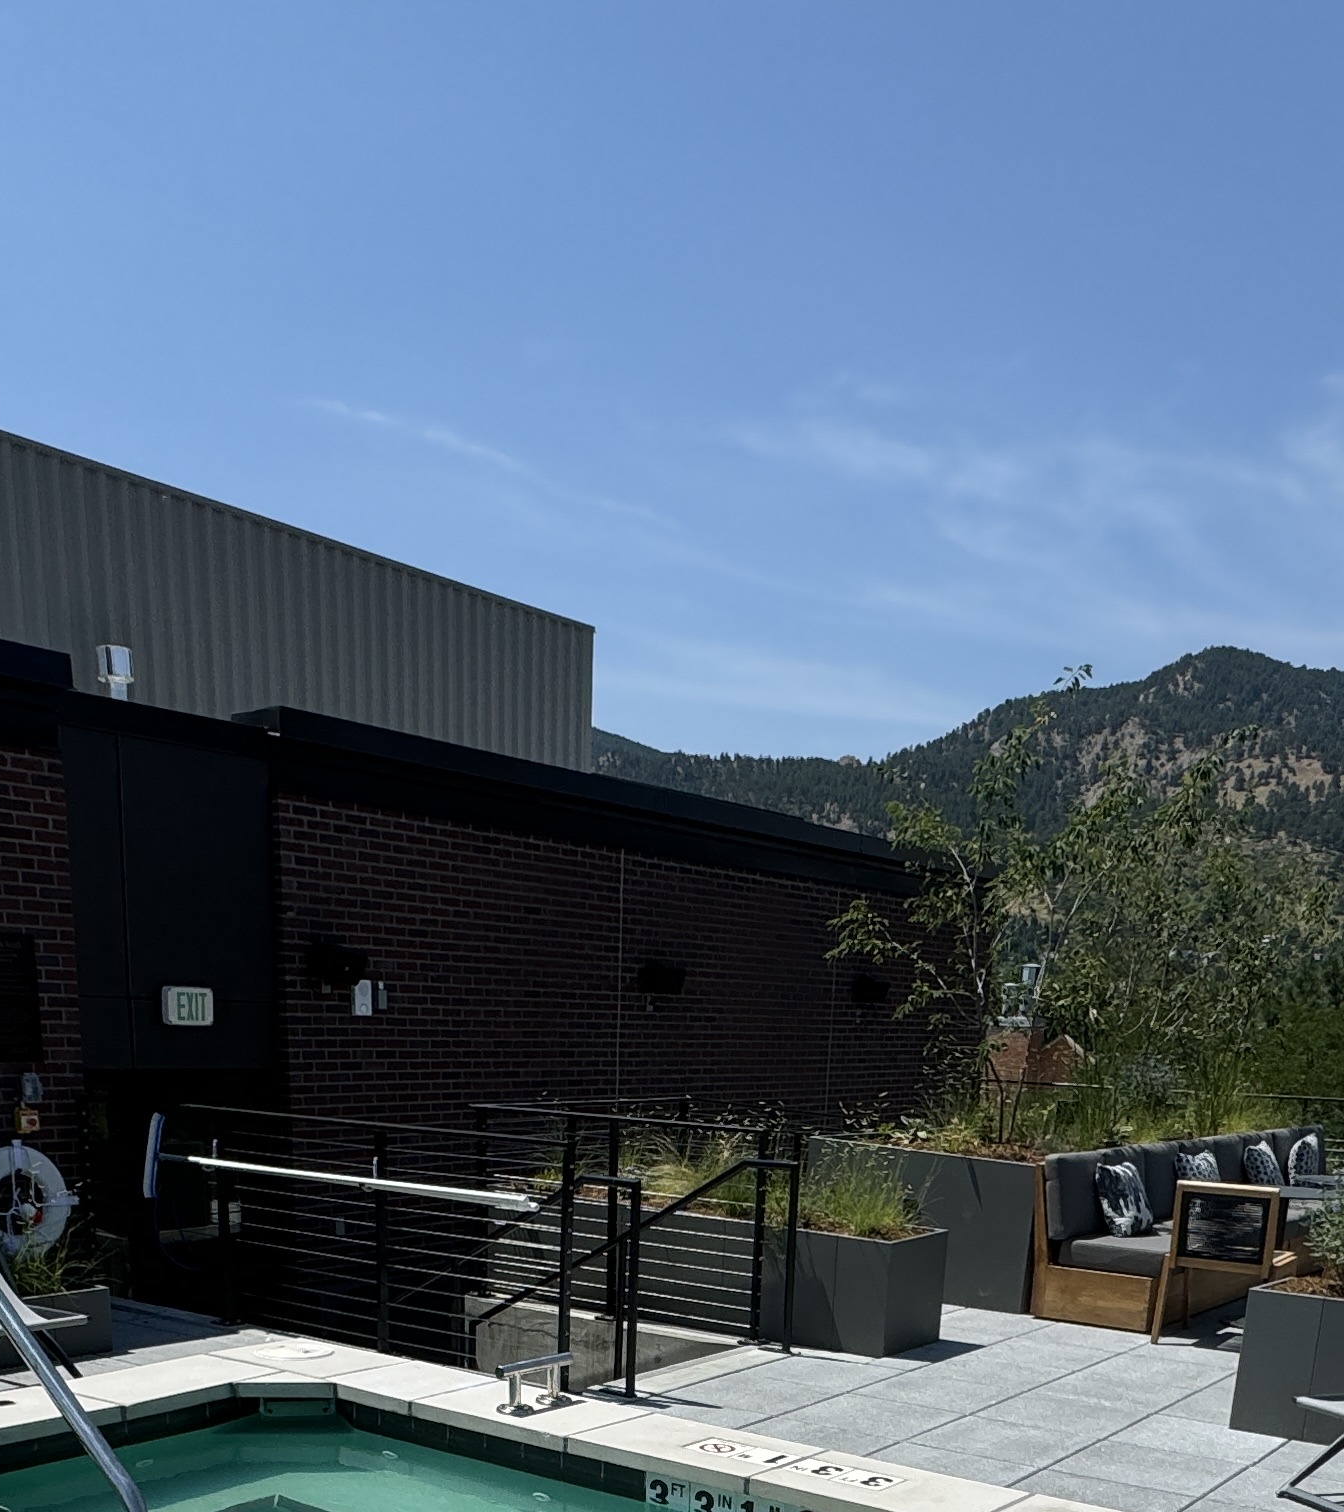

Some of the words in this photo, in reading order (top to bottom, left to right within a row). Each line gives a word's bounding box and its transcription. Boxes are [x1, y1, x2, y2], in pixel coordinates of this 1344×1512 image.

[176, 991, 207, 1021] EXIT
[763, 1454, 788, 1464] 1
[811, 1466, 844, 1476] 3
[860, 1476, 894, 1487] 3
[649, 1479, 669, 1505] 3
[670, 1482, 687, 1498] FT
[717, 1493, 733, 1510] IN
